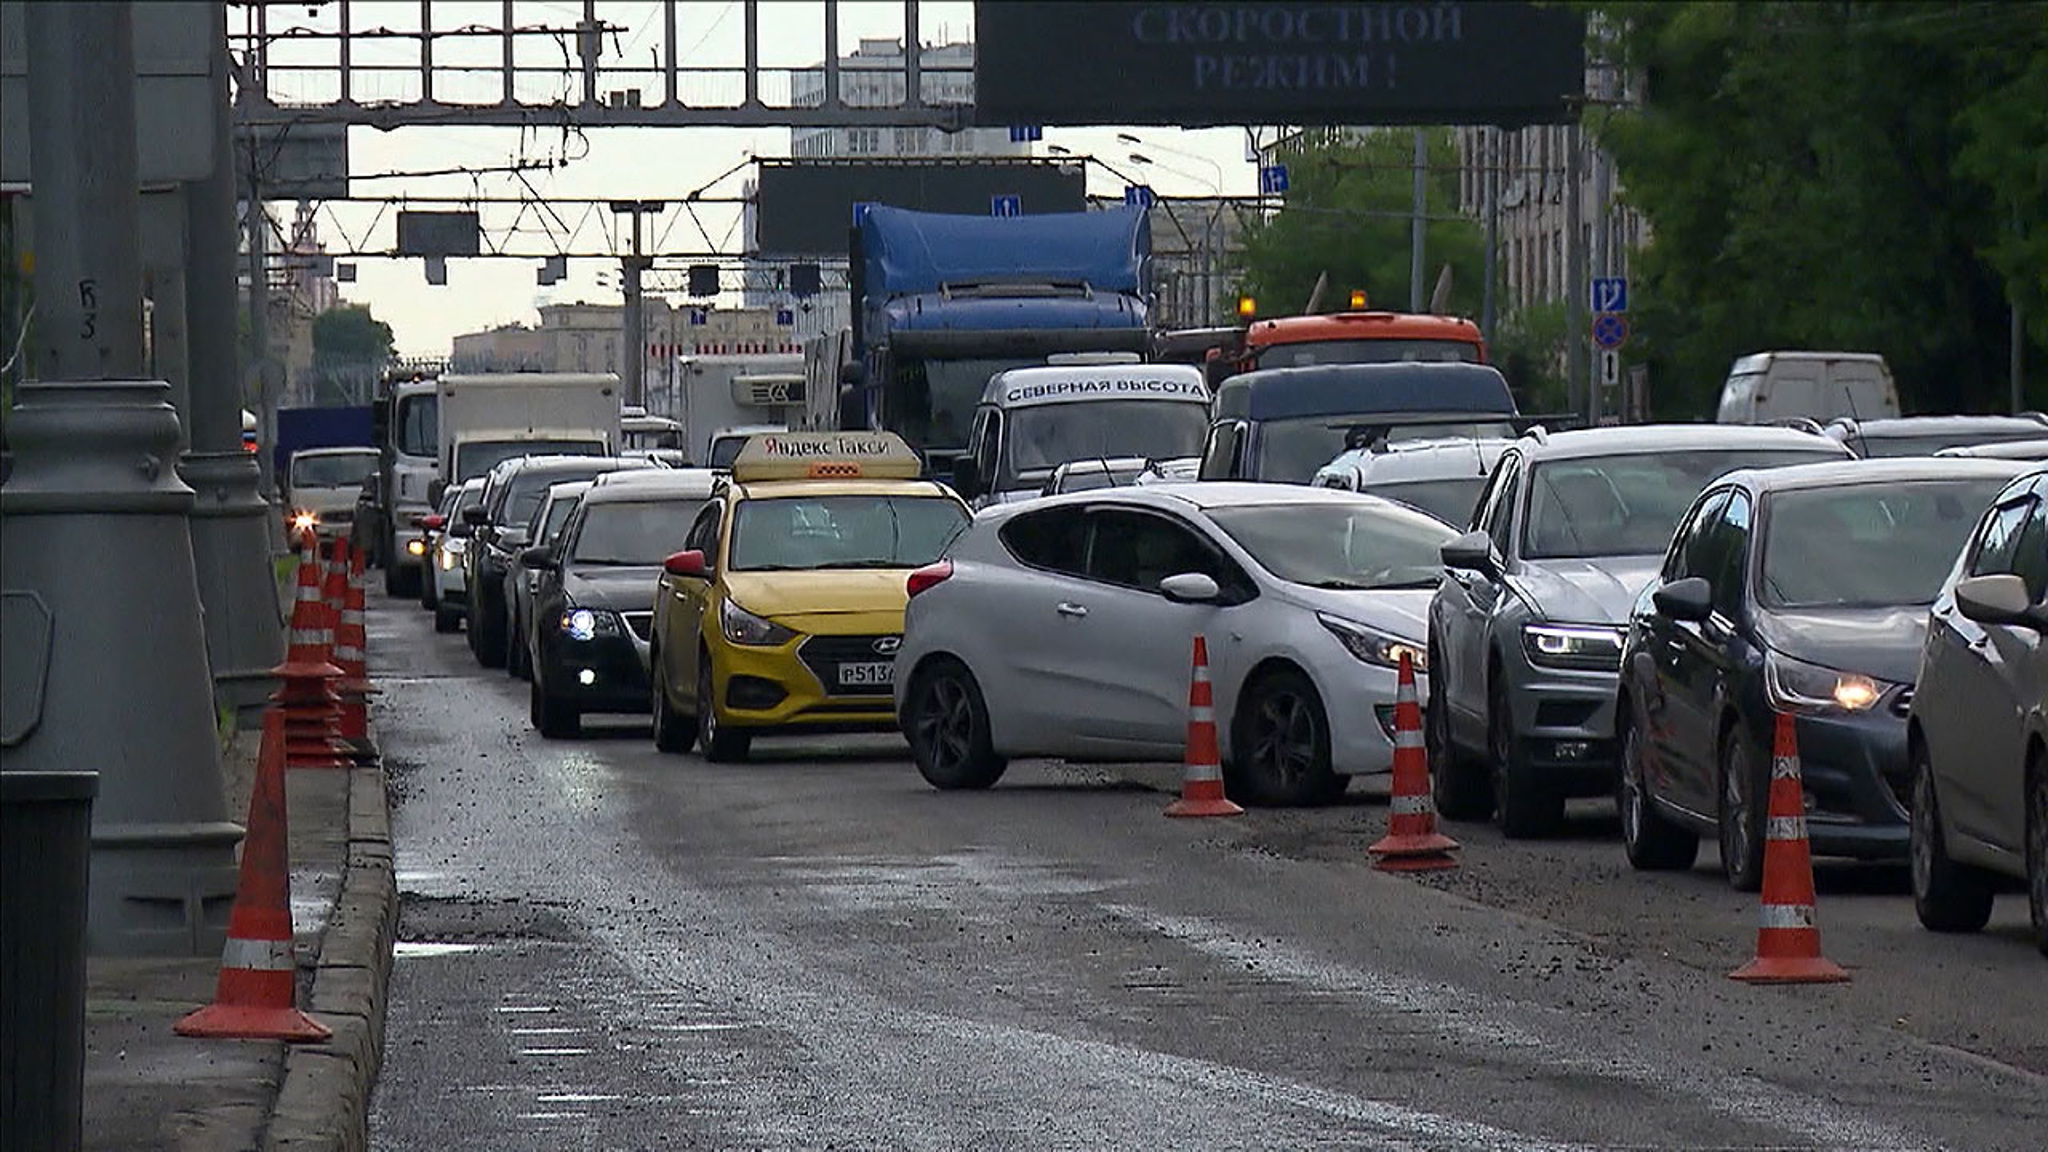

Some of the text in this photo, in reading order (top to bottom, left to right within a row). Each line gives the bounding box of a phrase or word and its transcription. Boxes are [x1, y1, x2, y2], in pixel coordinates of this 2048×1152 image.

[1132, 1, 1463, 43] СКОРОСТНОЙ
[1193, 52, 1369, 88] РЕЖИМ
[1007, 378, 1205, 401] СЕВЕРНАЯ ВЫСОТА
[764, 437, 891, 456] Яндекс Такси
